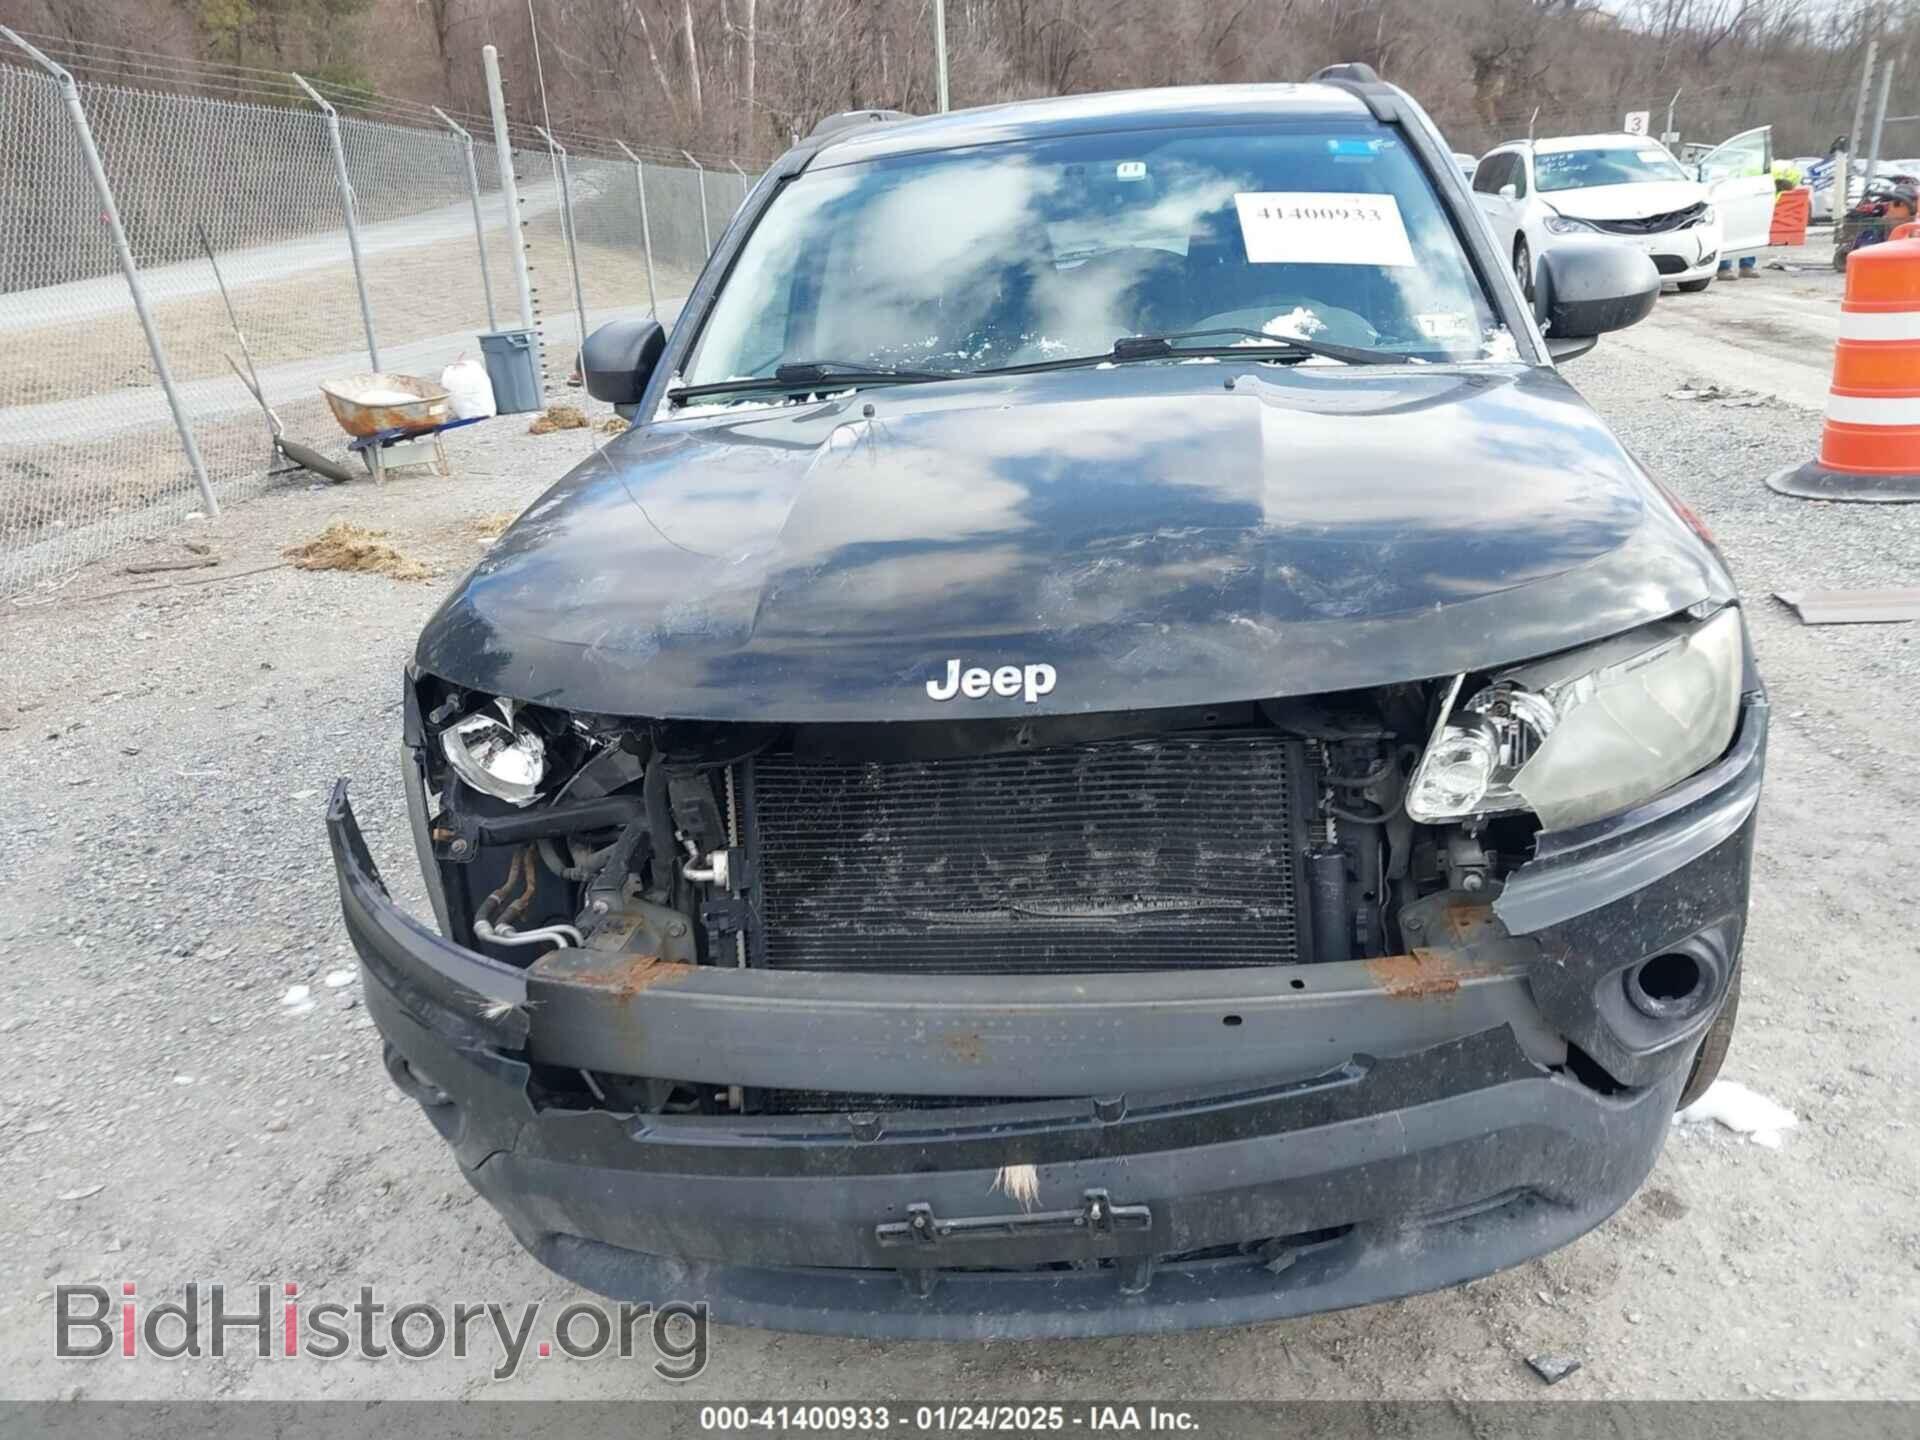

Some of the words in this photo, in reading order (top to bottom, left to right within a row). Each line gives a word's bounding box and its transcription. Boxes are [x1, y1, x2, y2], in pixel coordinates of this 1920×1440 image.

[1631, 116, 1641, 132] 3
[1257, 207, 1382, 221] 41400933
[926, 659, 1056, 702] Jeep
